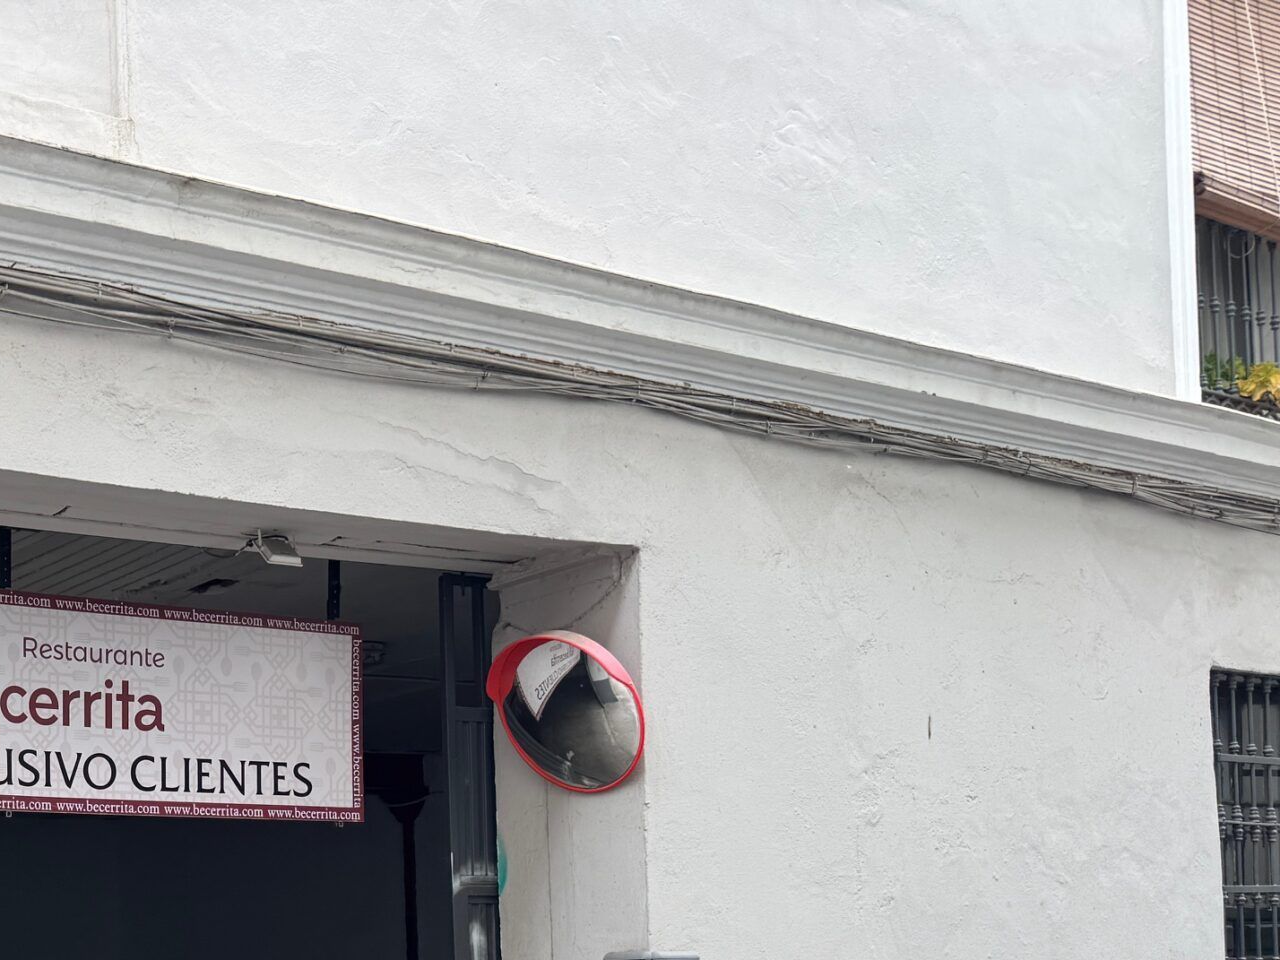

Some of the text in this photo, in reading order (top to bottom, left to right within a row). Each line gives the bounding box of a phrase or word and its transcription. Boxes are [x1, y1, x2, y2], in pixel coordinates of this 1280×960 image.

[55, 599, 160, 618] www.becerrita.com
[164, 608, 263, 627] www.becerrita.com
[267, 617, 360, 635] www.becerrita.com
[22, 636, 166, 668] Restaurante
[351, 639, 364, 808] becerrita.com www.becerrita
[131, 754, 313, 798] CLIENTES
[56, 800, 160, 814] www.becerrita.com
[164, 804, 264, 817] www.becerrita.com
[268, 807, 361, 820] www.becerrita.com
